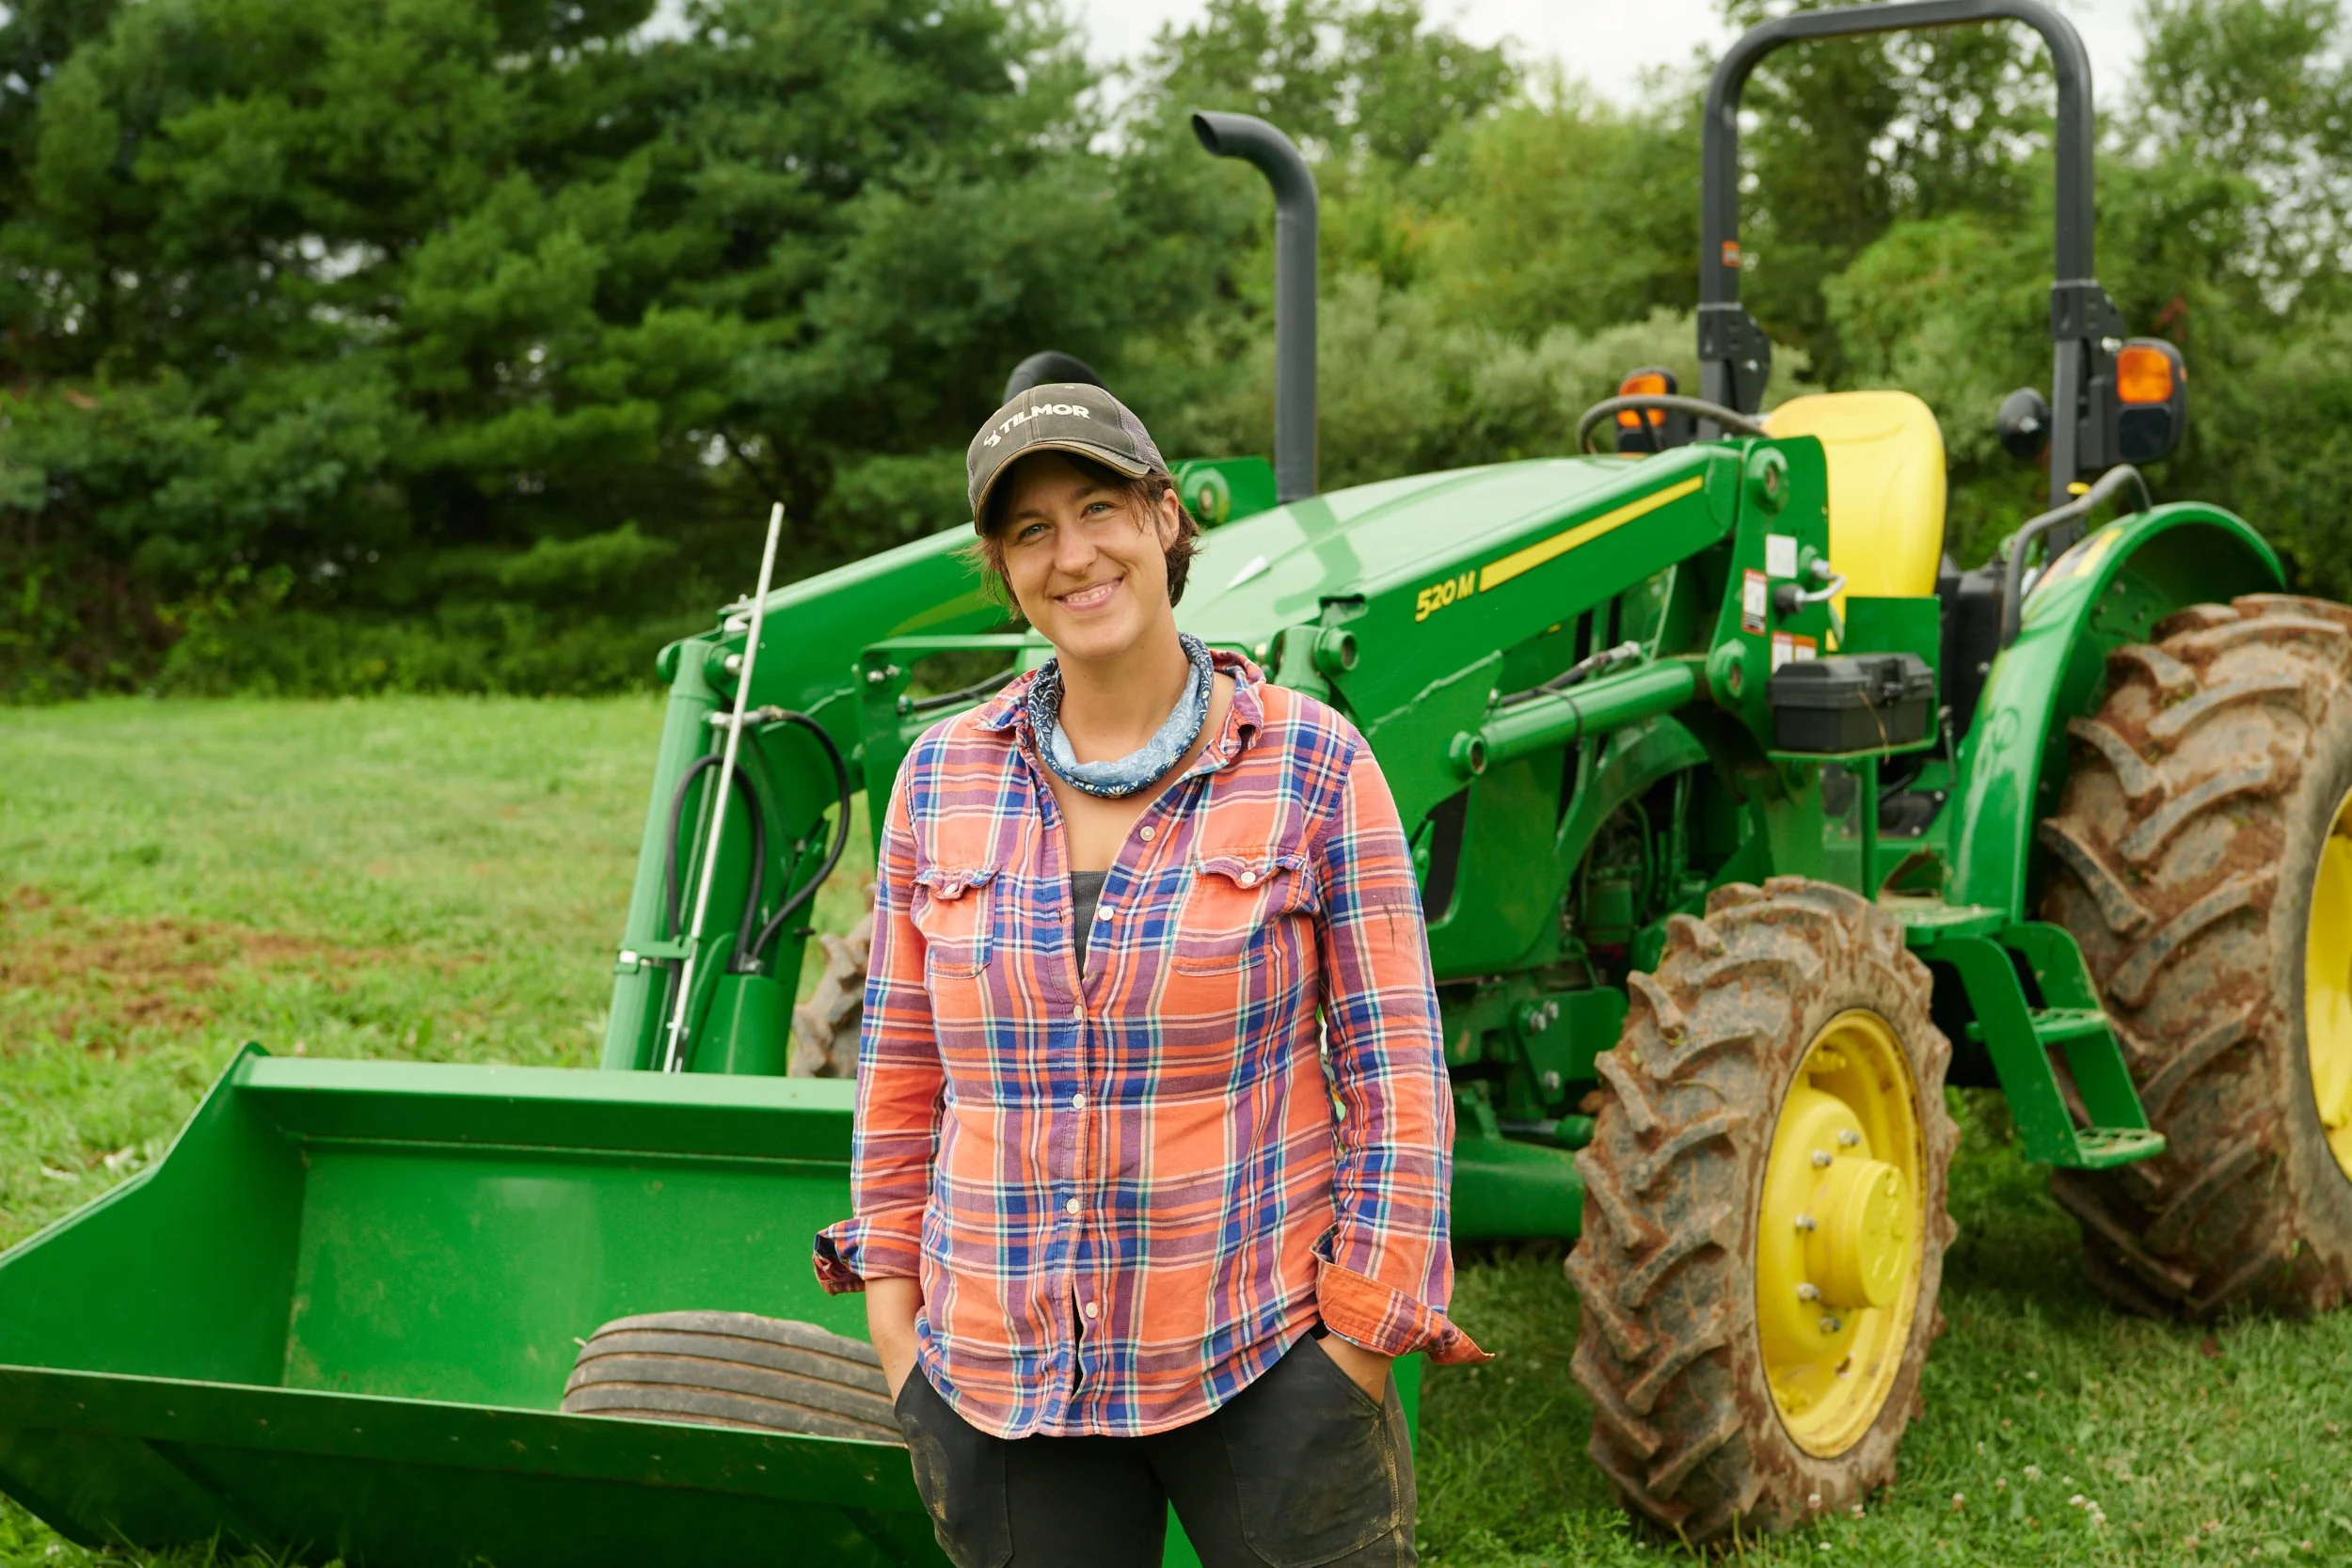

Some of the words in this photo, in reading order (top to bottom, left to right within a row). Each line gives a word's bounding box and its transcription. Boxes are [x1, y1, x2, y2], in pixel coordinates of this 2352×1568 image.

[999, 404, 1090, 434] TILMOR
[1415, 578, 1457, 622] 520
[1457, 569, 1477, 600] M
